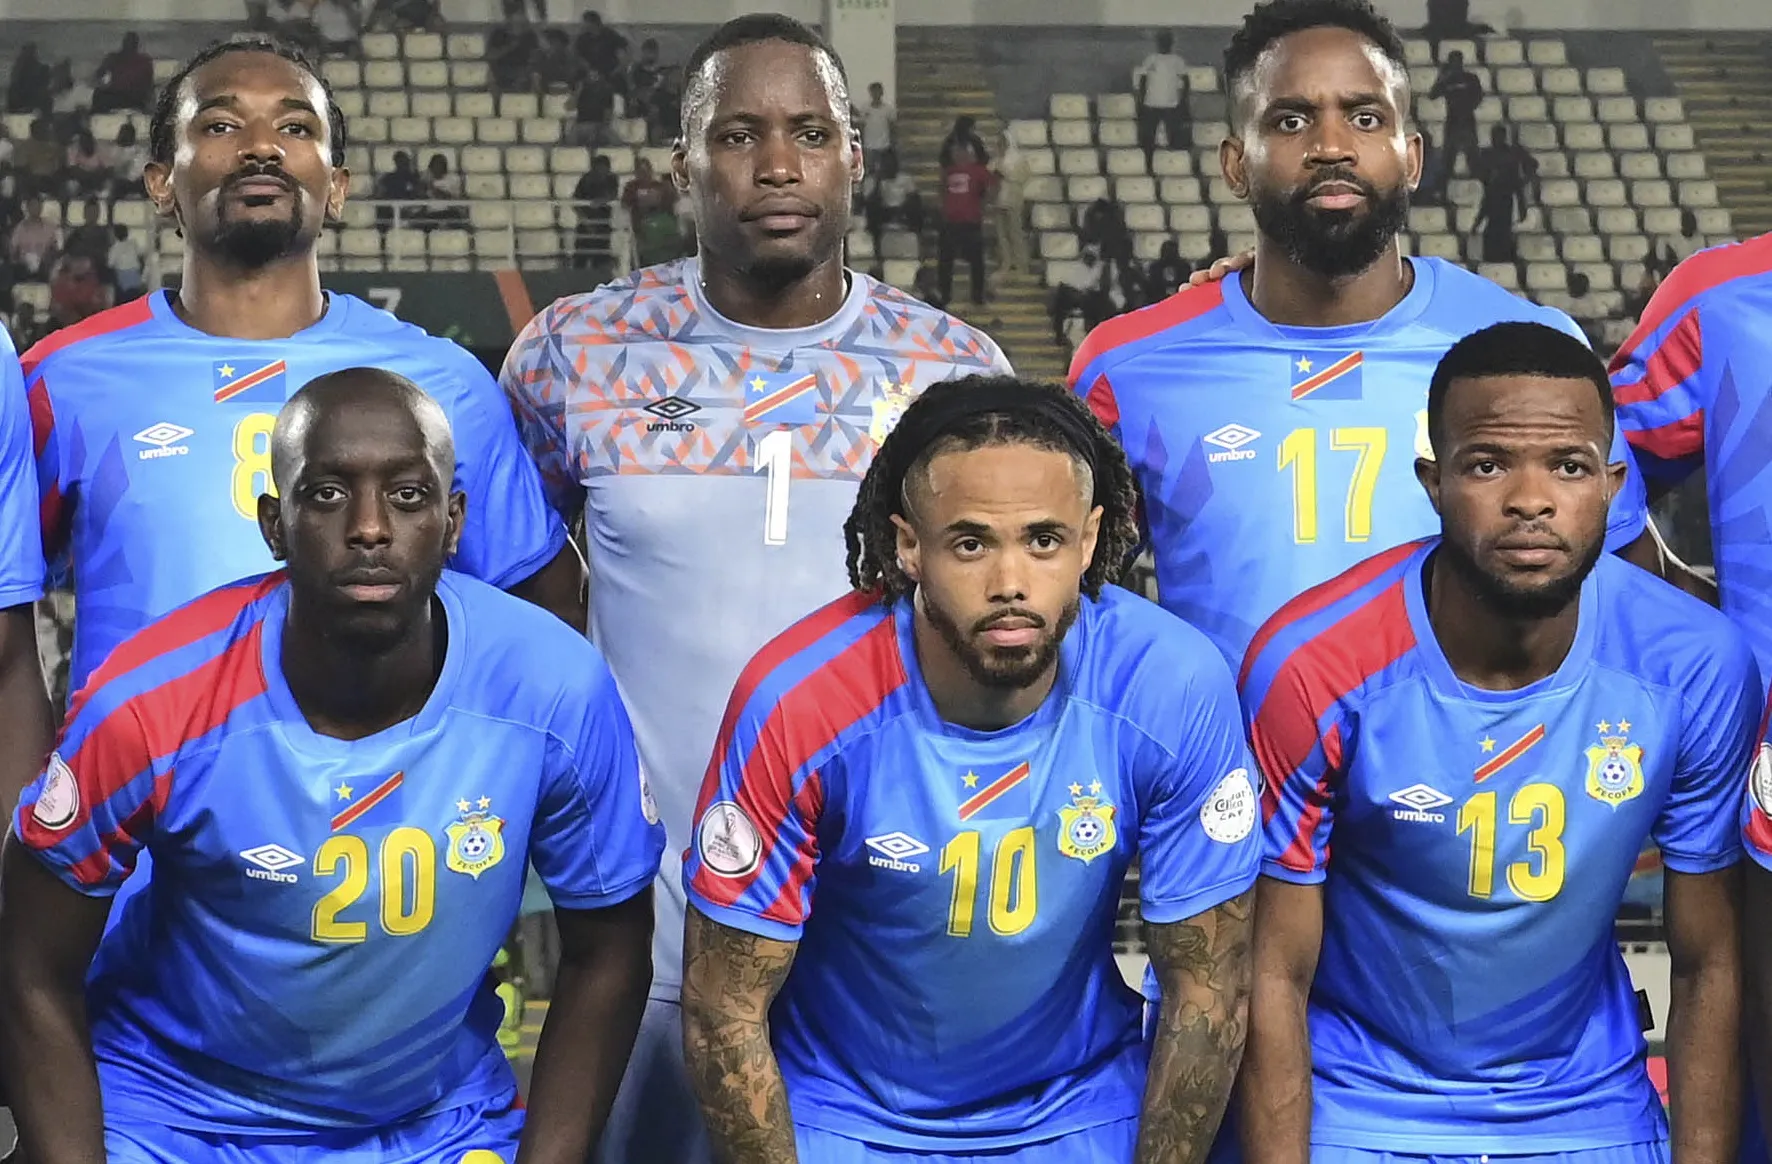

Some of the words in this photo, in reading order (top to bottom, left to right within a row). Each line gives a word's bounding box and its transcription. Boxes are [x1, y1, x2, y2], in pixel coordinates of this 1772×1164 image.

[139, 445, 188, 459] umbro
[646, 421, 695, 433] umbro
[1208, 449, 1256, 463] umbro
[231, 412, 280, 522] 8
[753, 430, 793, 546] 1
[1277, 427, 1389, 545] 17
[1393, 809, 1445, 823] umbro
[1455, 782, 1567, 903] 13
[245, 868, 298, 883] umbro
[310, 826, 436, 944] 20
[868, 855, 920, 873] umbro
[938, 826, 1038, 938] 10
